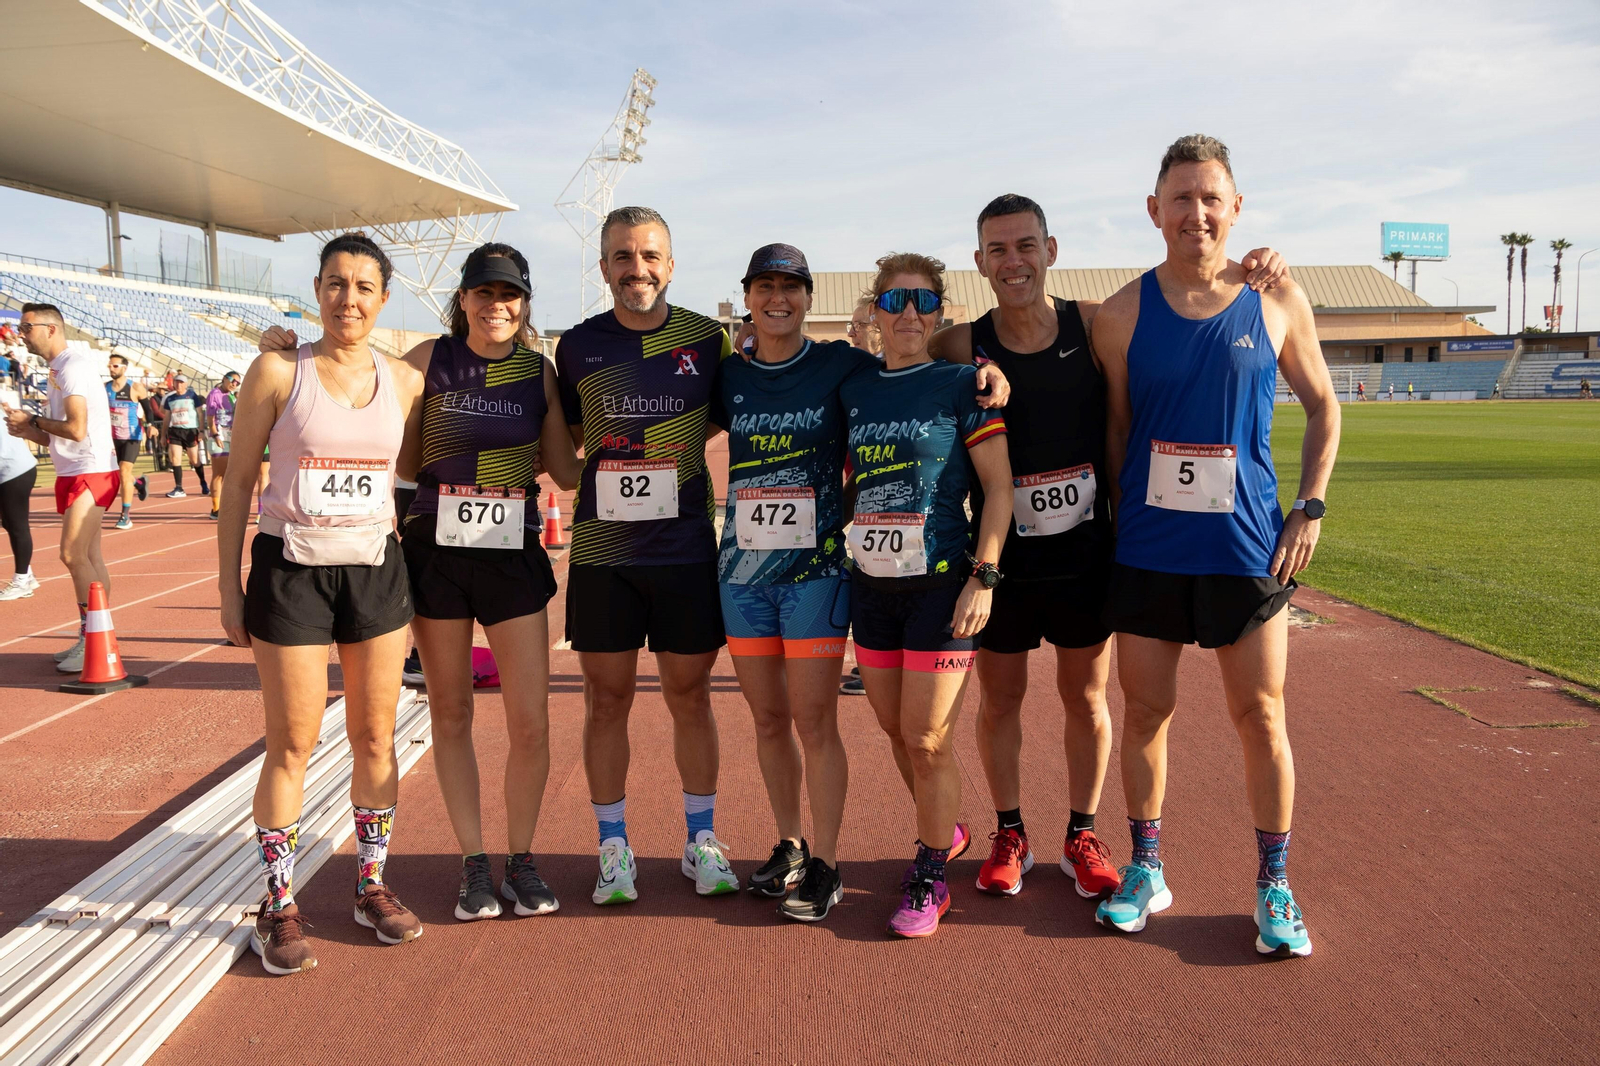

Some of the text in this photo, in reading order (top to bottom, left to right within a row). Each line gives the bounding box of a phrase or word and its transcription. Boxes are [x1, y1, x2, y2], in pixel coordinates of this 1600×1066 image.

[1390, 230, 1443, 242] PRIMARK
[442, 391, 523, 416] El Arbolito
[602, 395, 685, 412] El Arbolito
[731, 406, 825, 437] AGAPORNIS
[749, 434, 793, 453] TEAM
[856, 444, 897, 465] TEAM
[1178, 461, 1195, 485] 5
[321, 474, 373, 498] 446
[620, 475, 651, 498] 82
[1031, 484, 1079, 513] 680
[457, 501, 505, 525] 670
[751, 503, 797, 526] 472
[862, 529, 904, 554] 570
[356, 815, 393, 842] RUN
